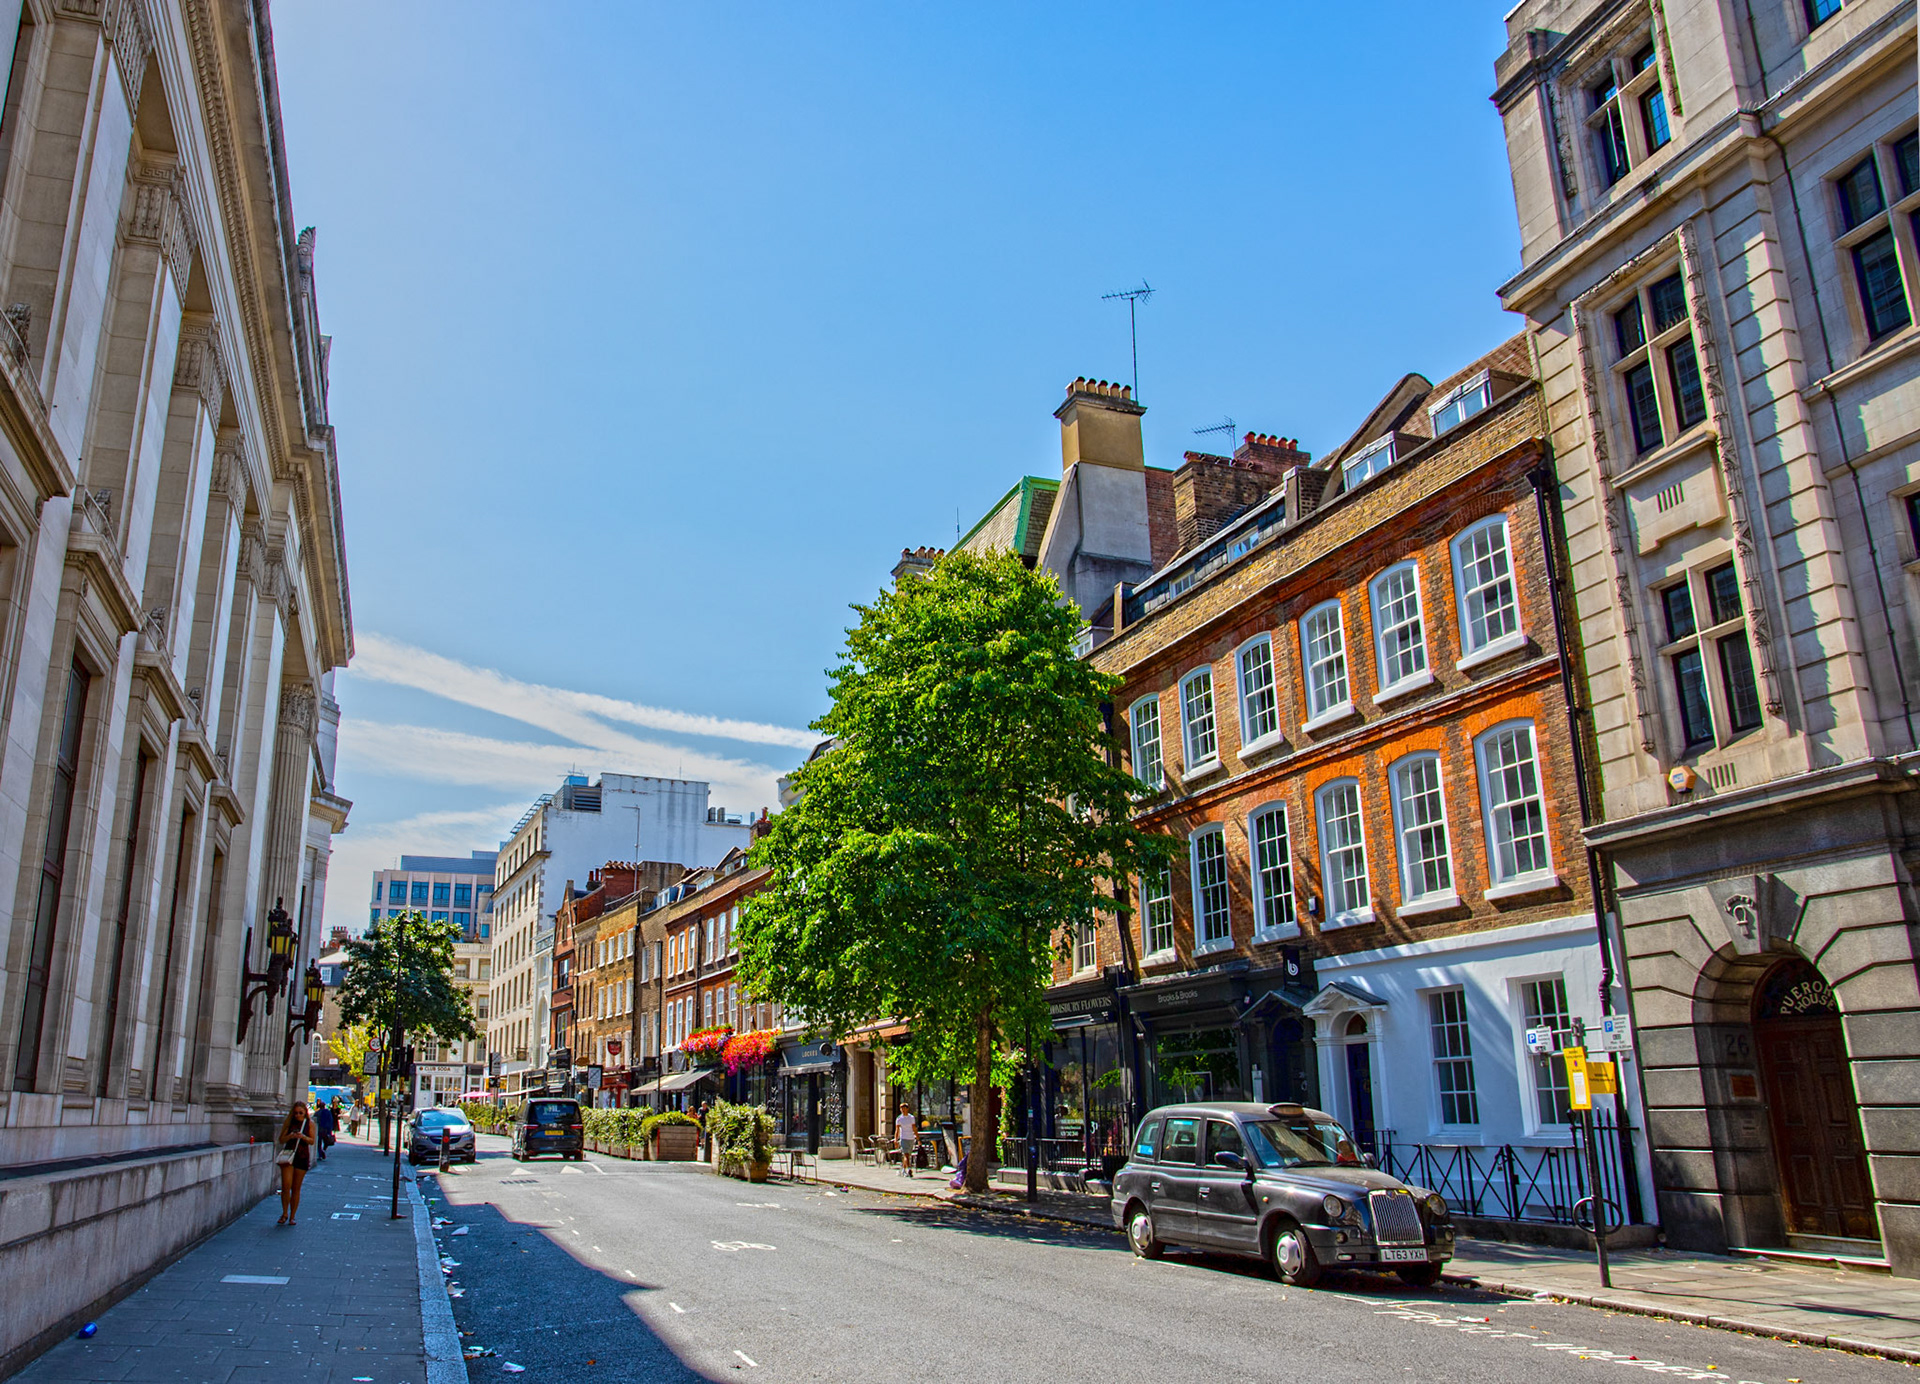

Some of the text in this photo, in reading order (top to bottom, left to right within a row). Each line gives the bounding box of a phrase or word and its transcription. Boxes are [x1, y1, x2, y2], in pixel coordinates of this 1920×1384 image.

[1081, 996, 1112, 1011] FLOWERS
[1725, 1034, 1749, 1057] 26
[1384, 1249, 1425, 1260] LT63 YXH
